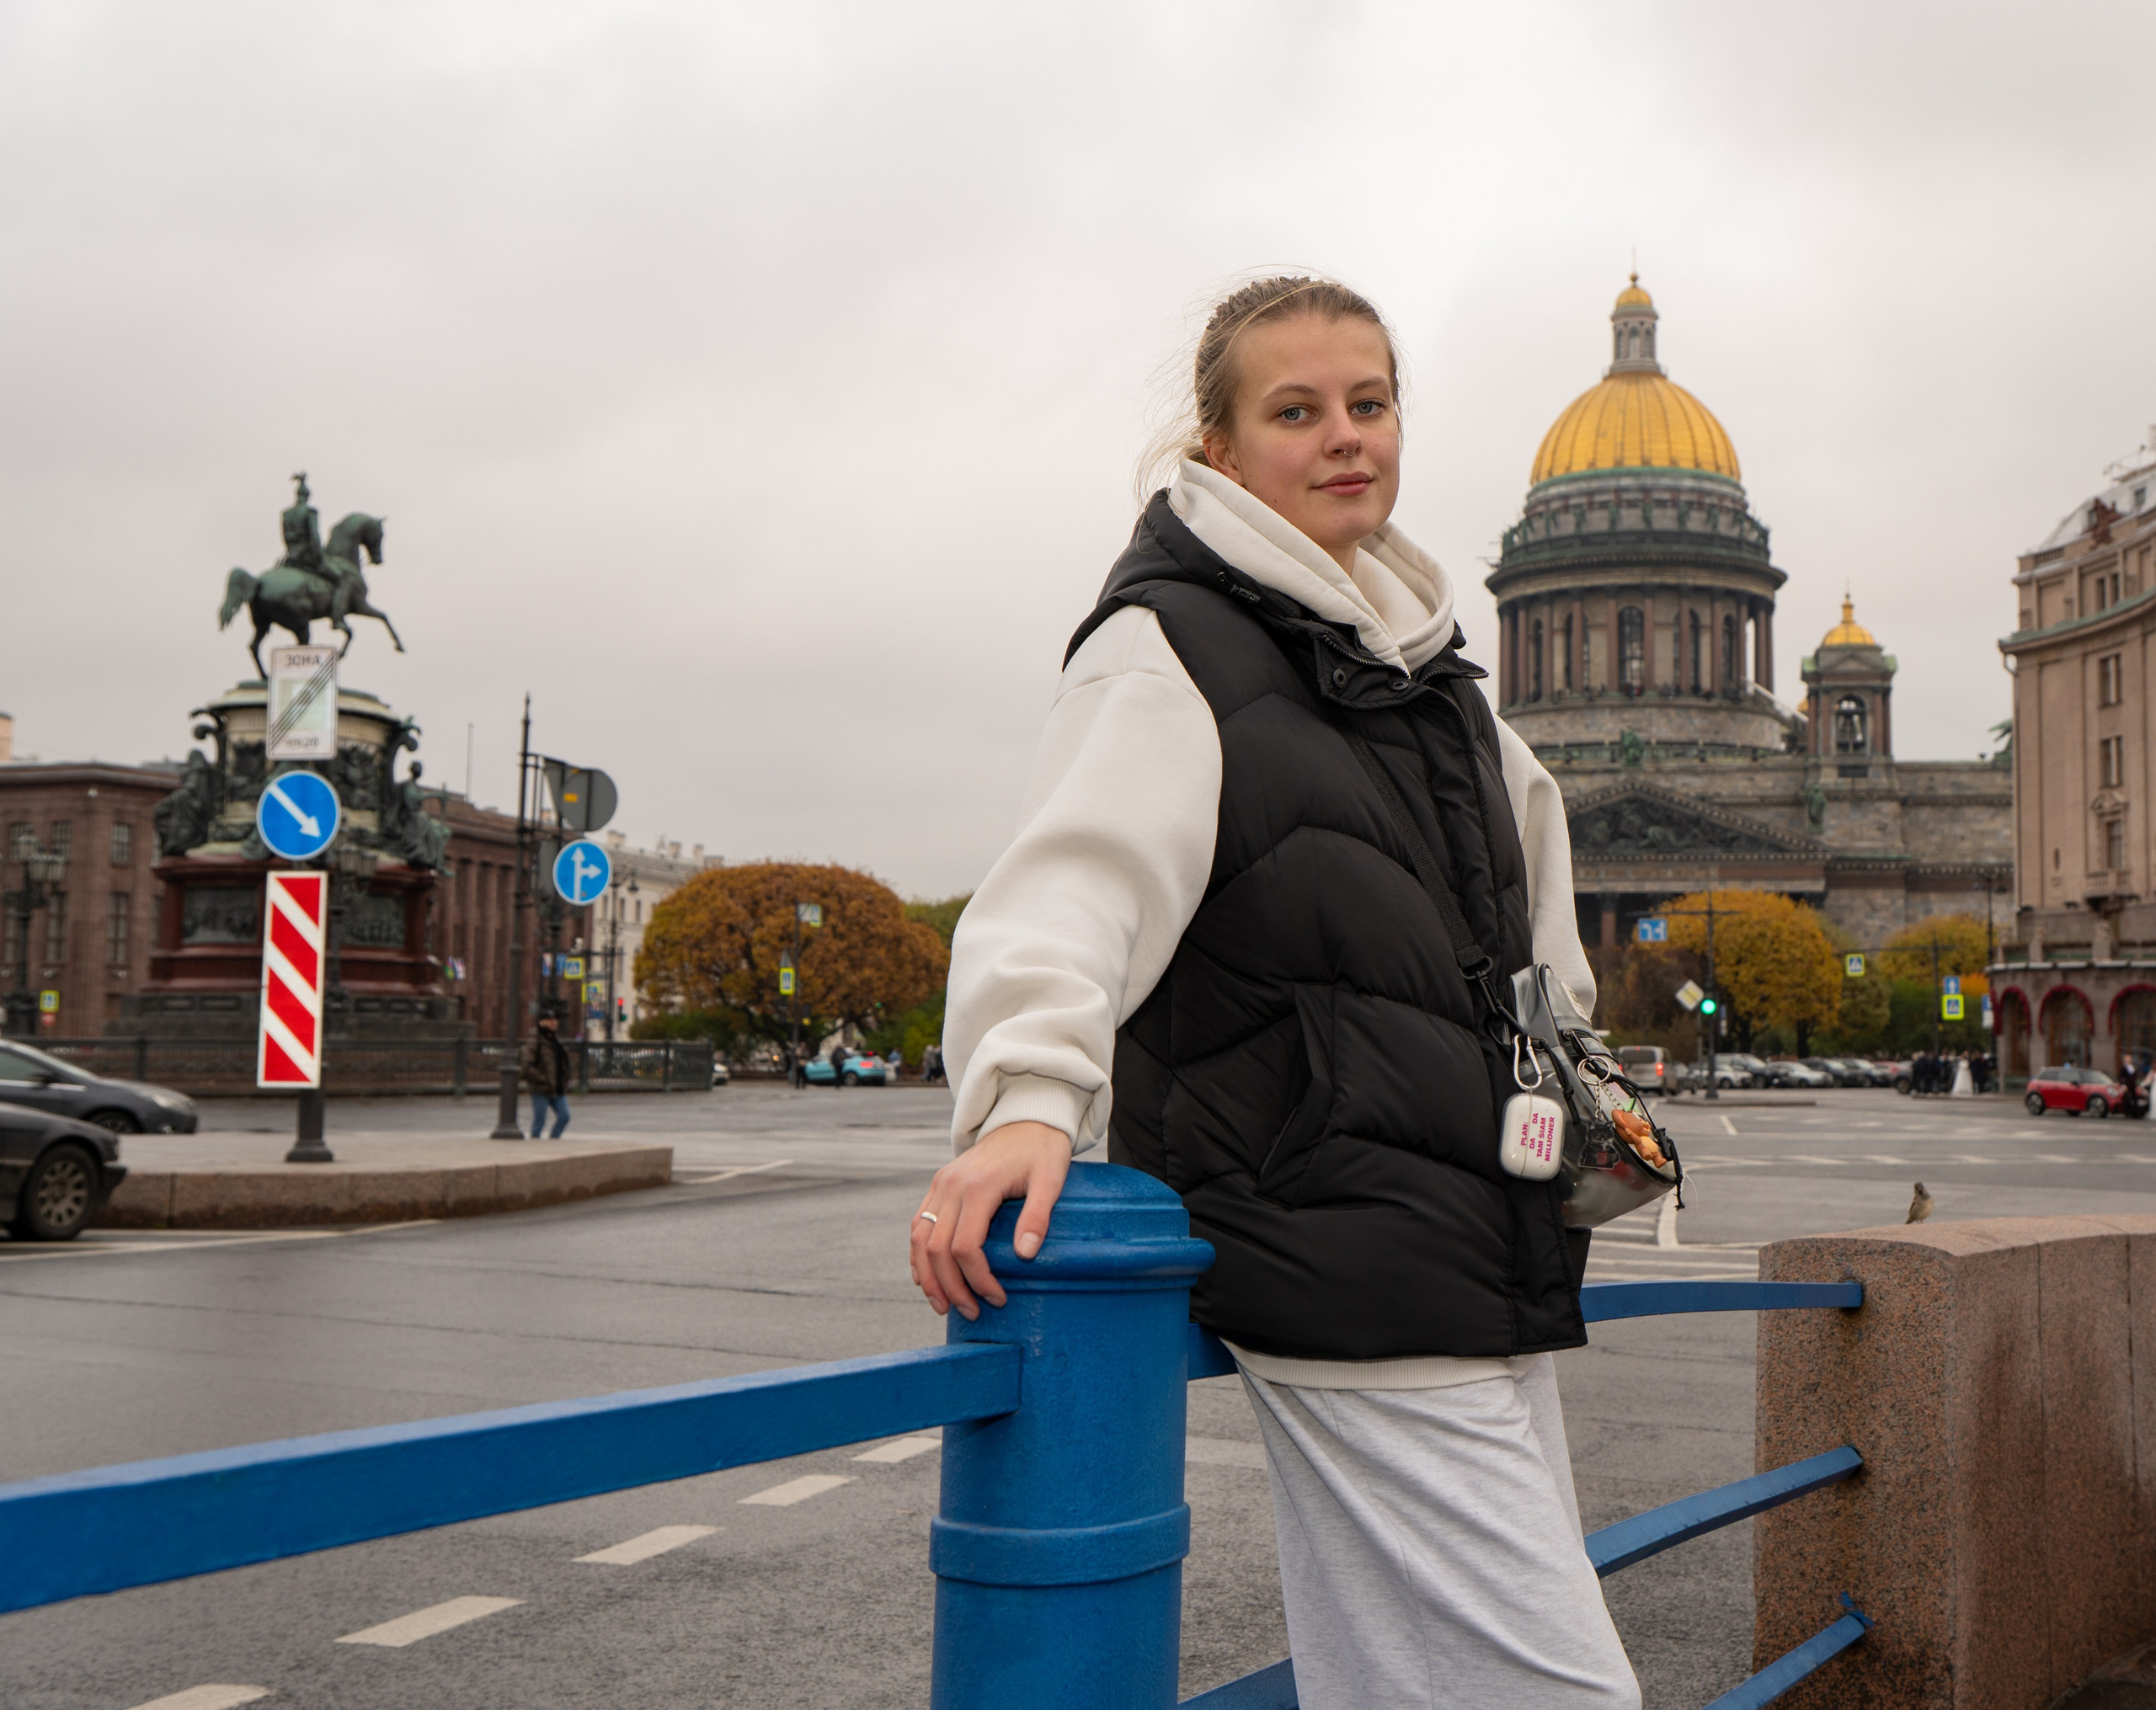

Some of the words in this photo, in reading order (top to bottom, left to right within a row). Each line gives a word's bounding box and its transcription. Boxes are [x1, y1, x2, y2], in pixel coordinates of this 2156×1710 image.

[285, 653, 320, 667] ЗОНА
[1532, 1112, 1539, 1124] DA
[1529, 1137, 1536, 1149] DA
[1545, 1116, 1555, 1162] MILLIONER
